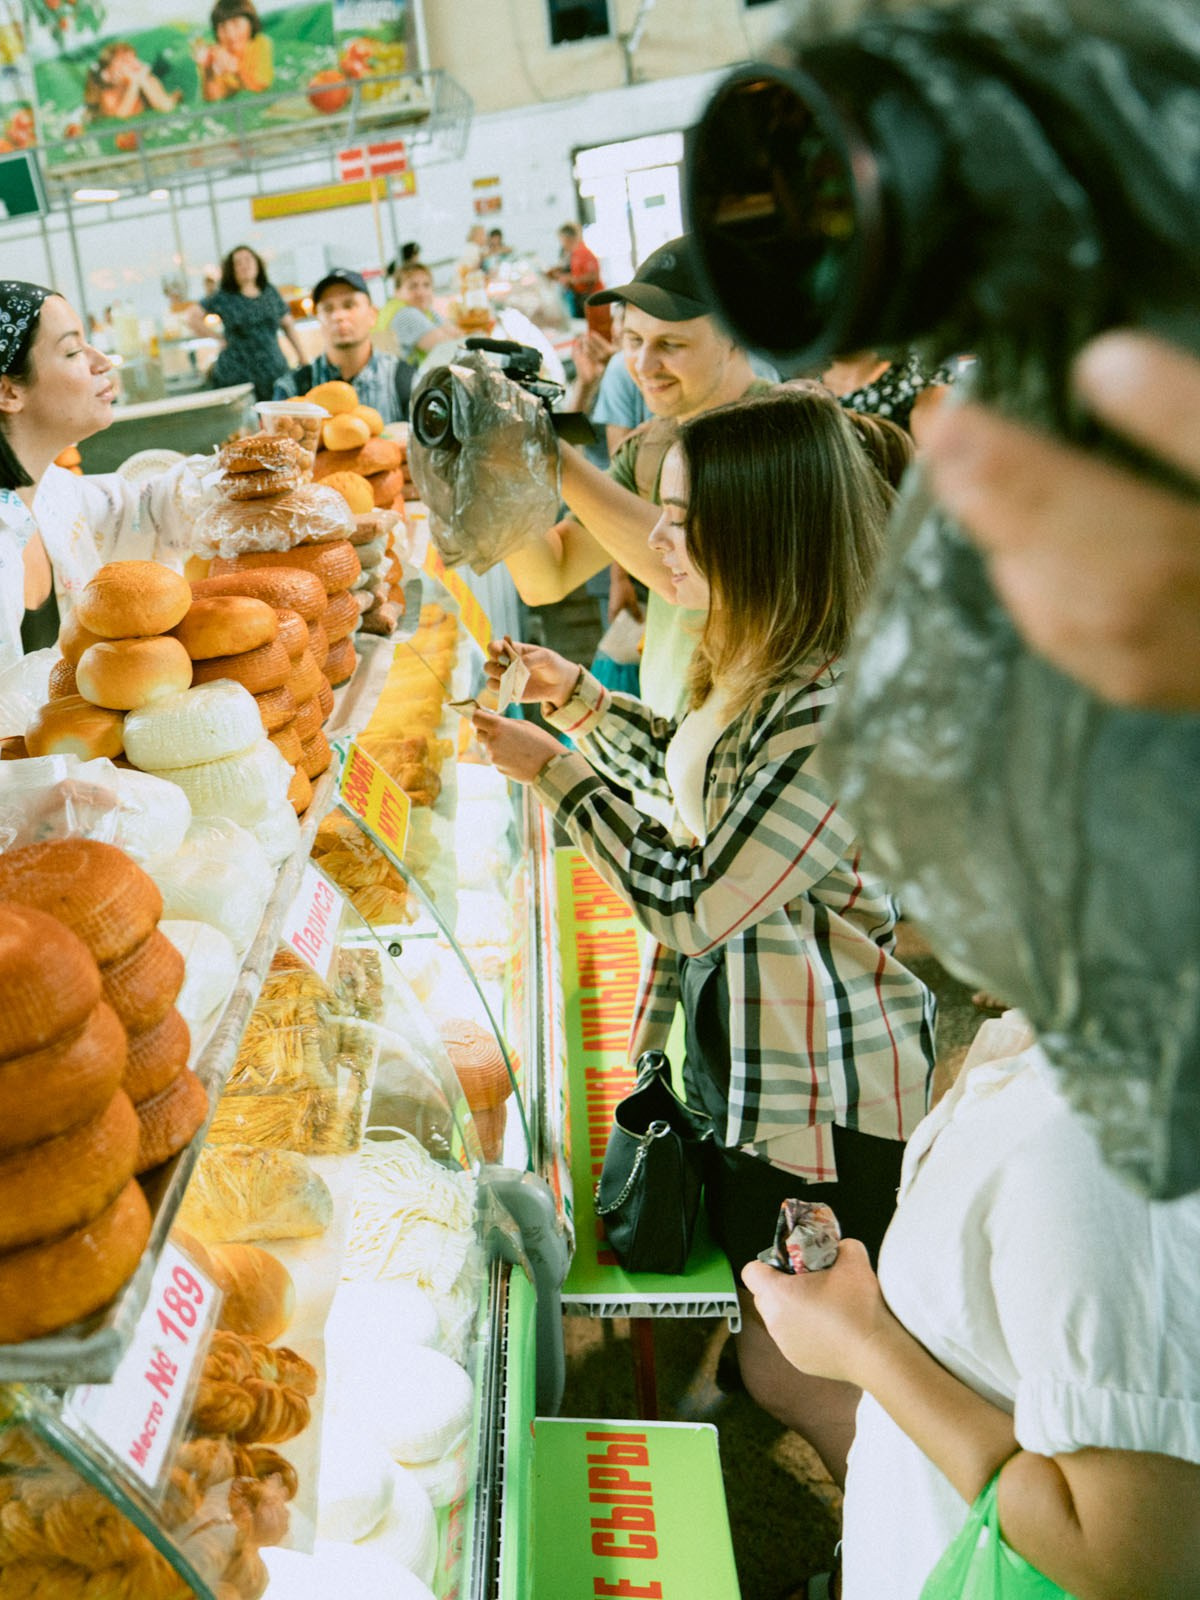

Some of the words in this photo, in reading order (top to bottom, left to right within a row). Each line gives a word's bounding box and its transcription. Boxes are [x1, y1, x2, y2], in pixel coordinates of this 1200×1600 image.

[291, 880, 335, 967] Лариса
[156, 1265, 204, 1345] 189
[586, 1431, 659, 1560] СЫРЫ
